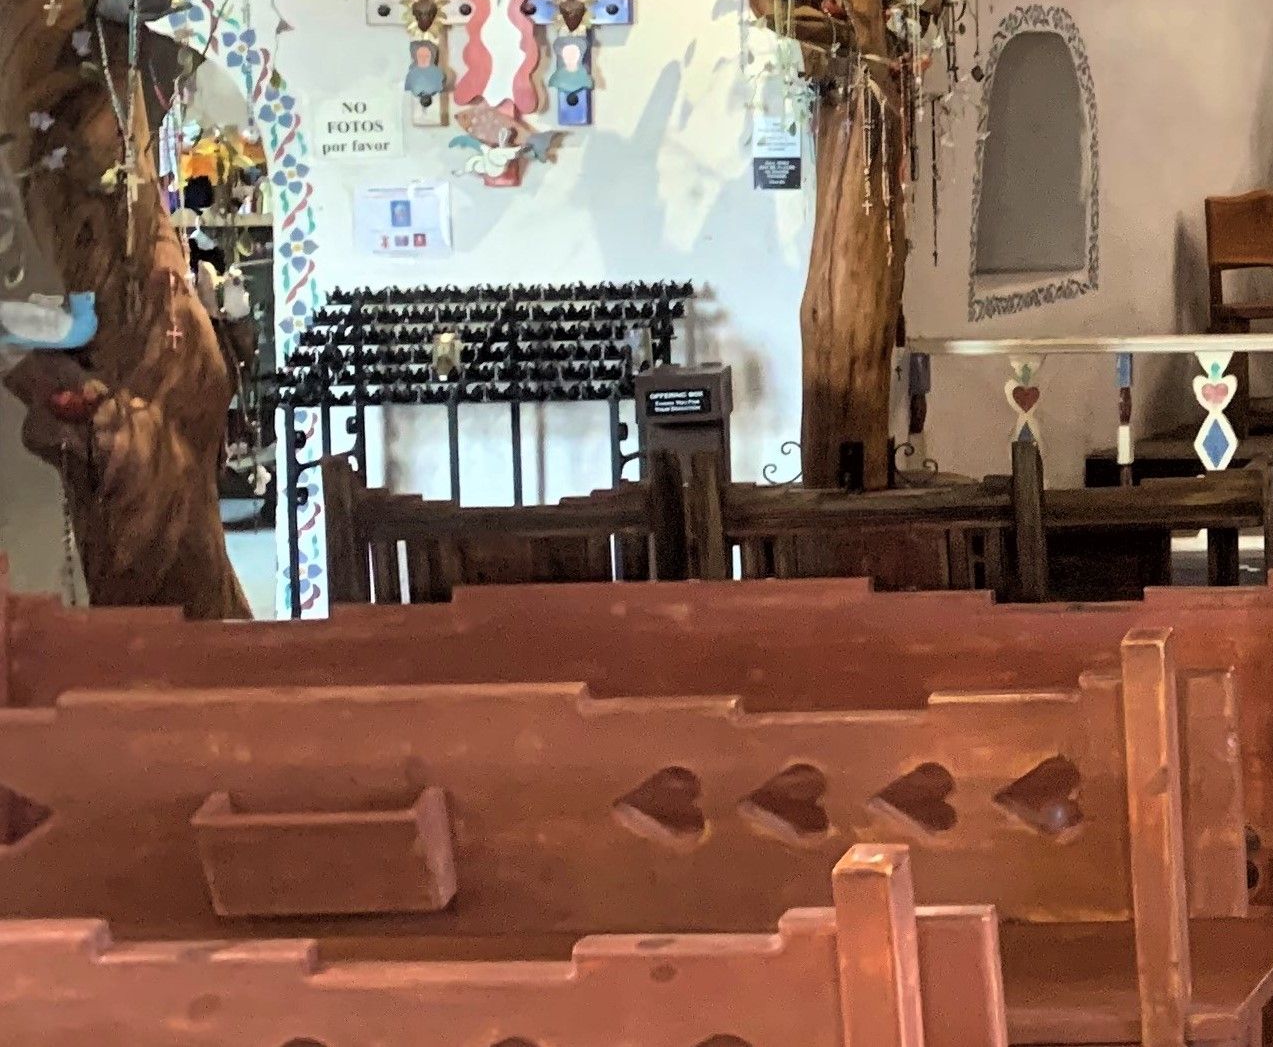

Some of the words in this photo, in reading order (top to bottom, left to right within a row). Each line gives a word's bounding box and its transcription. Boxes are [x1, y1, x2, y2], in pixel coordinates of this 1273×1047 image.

[342, 102, 367, 114] NO
[327, 121, 384, 134] FOTOS
[322, 143, 347, 155] por
[352, 140, 390, 152] favor
